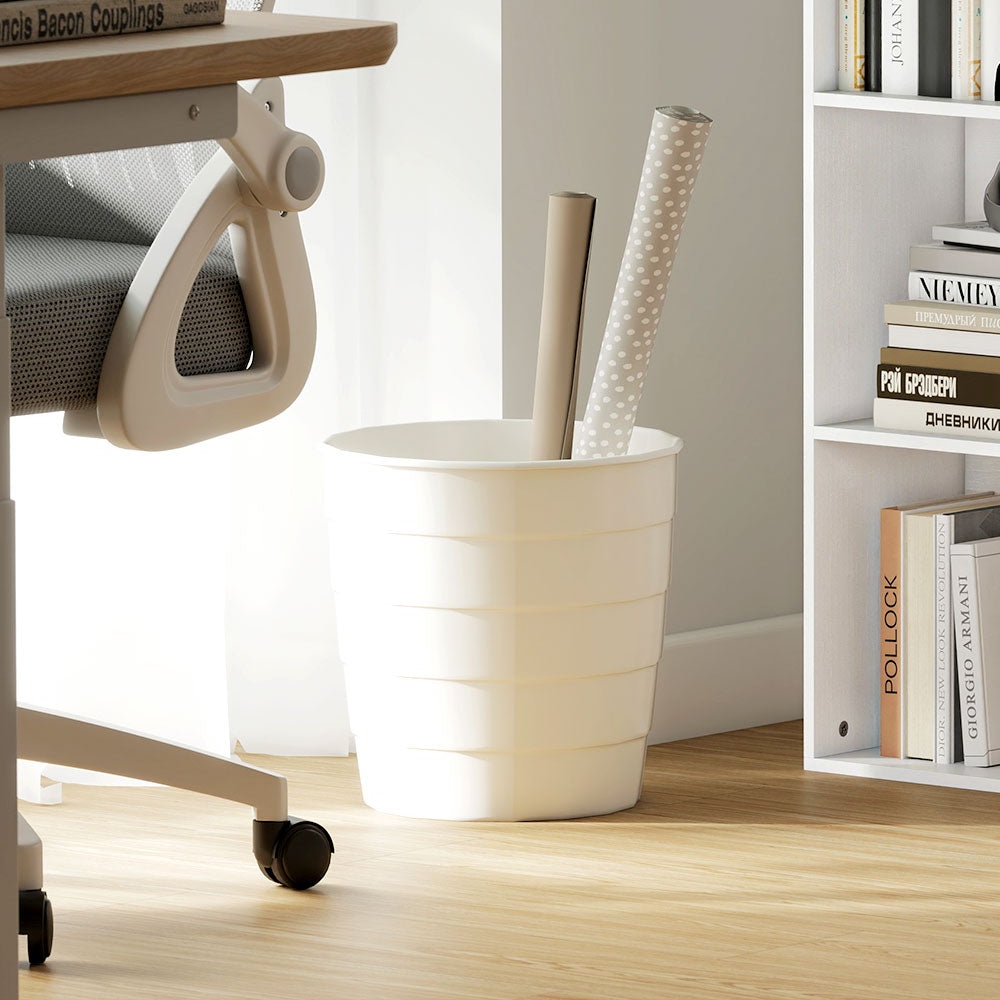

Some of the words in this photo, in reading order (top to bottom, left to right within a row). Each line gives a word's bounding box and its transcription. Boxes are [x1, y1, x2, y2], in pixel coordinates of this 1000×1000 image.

[0, 10, 32, 42] ncis
[38, 8, 84, 39] Bacon
[91, 0, 164, 35] Couplings
[915, 311, 977, 327] ПРЕМУДРЫЙ
[880, 367, 902, 394] РЭЙ
[905, 372, 957, 399] БРЭДБЕРИ
[925, 412, 1000, 432] ДНЕВНИКИ
[937, 521, 945, 623] REVOLUTION
[958, 575, 972, 651] ARMANI
[884, 575, 898, 694] POLLOCK
[937, 628, 946, 671] LOOK
[937, 673, 946, 711] NEW
[963, 658, 979, 739] GIORGIO
